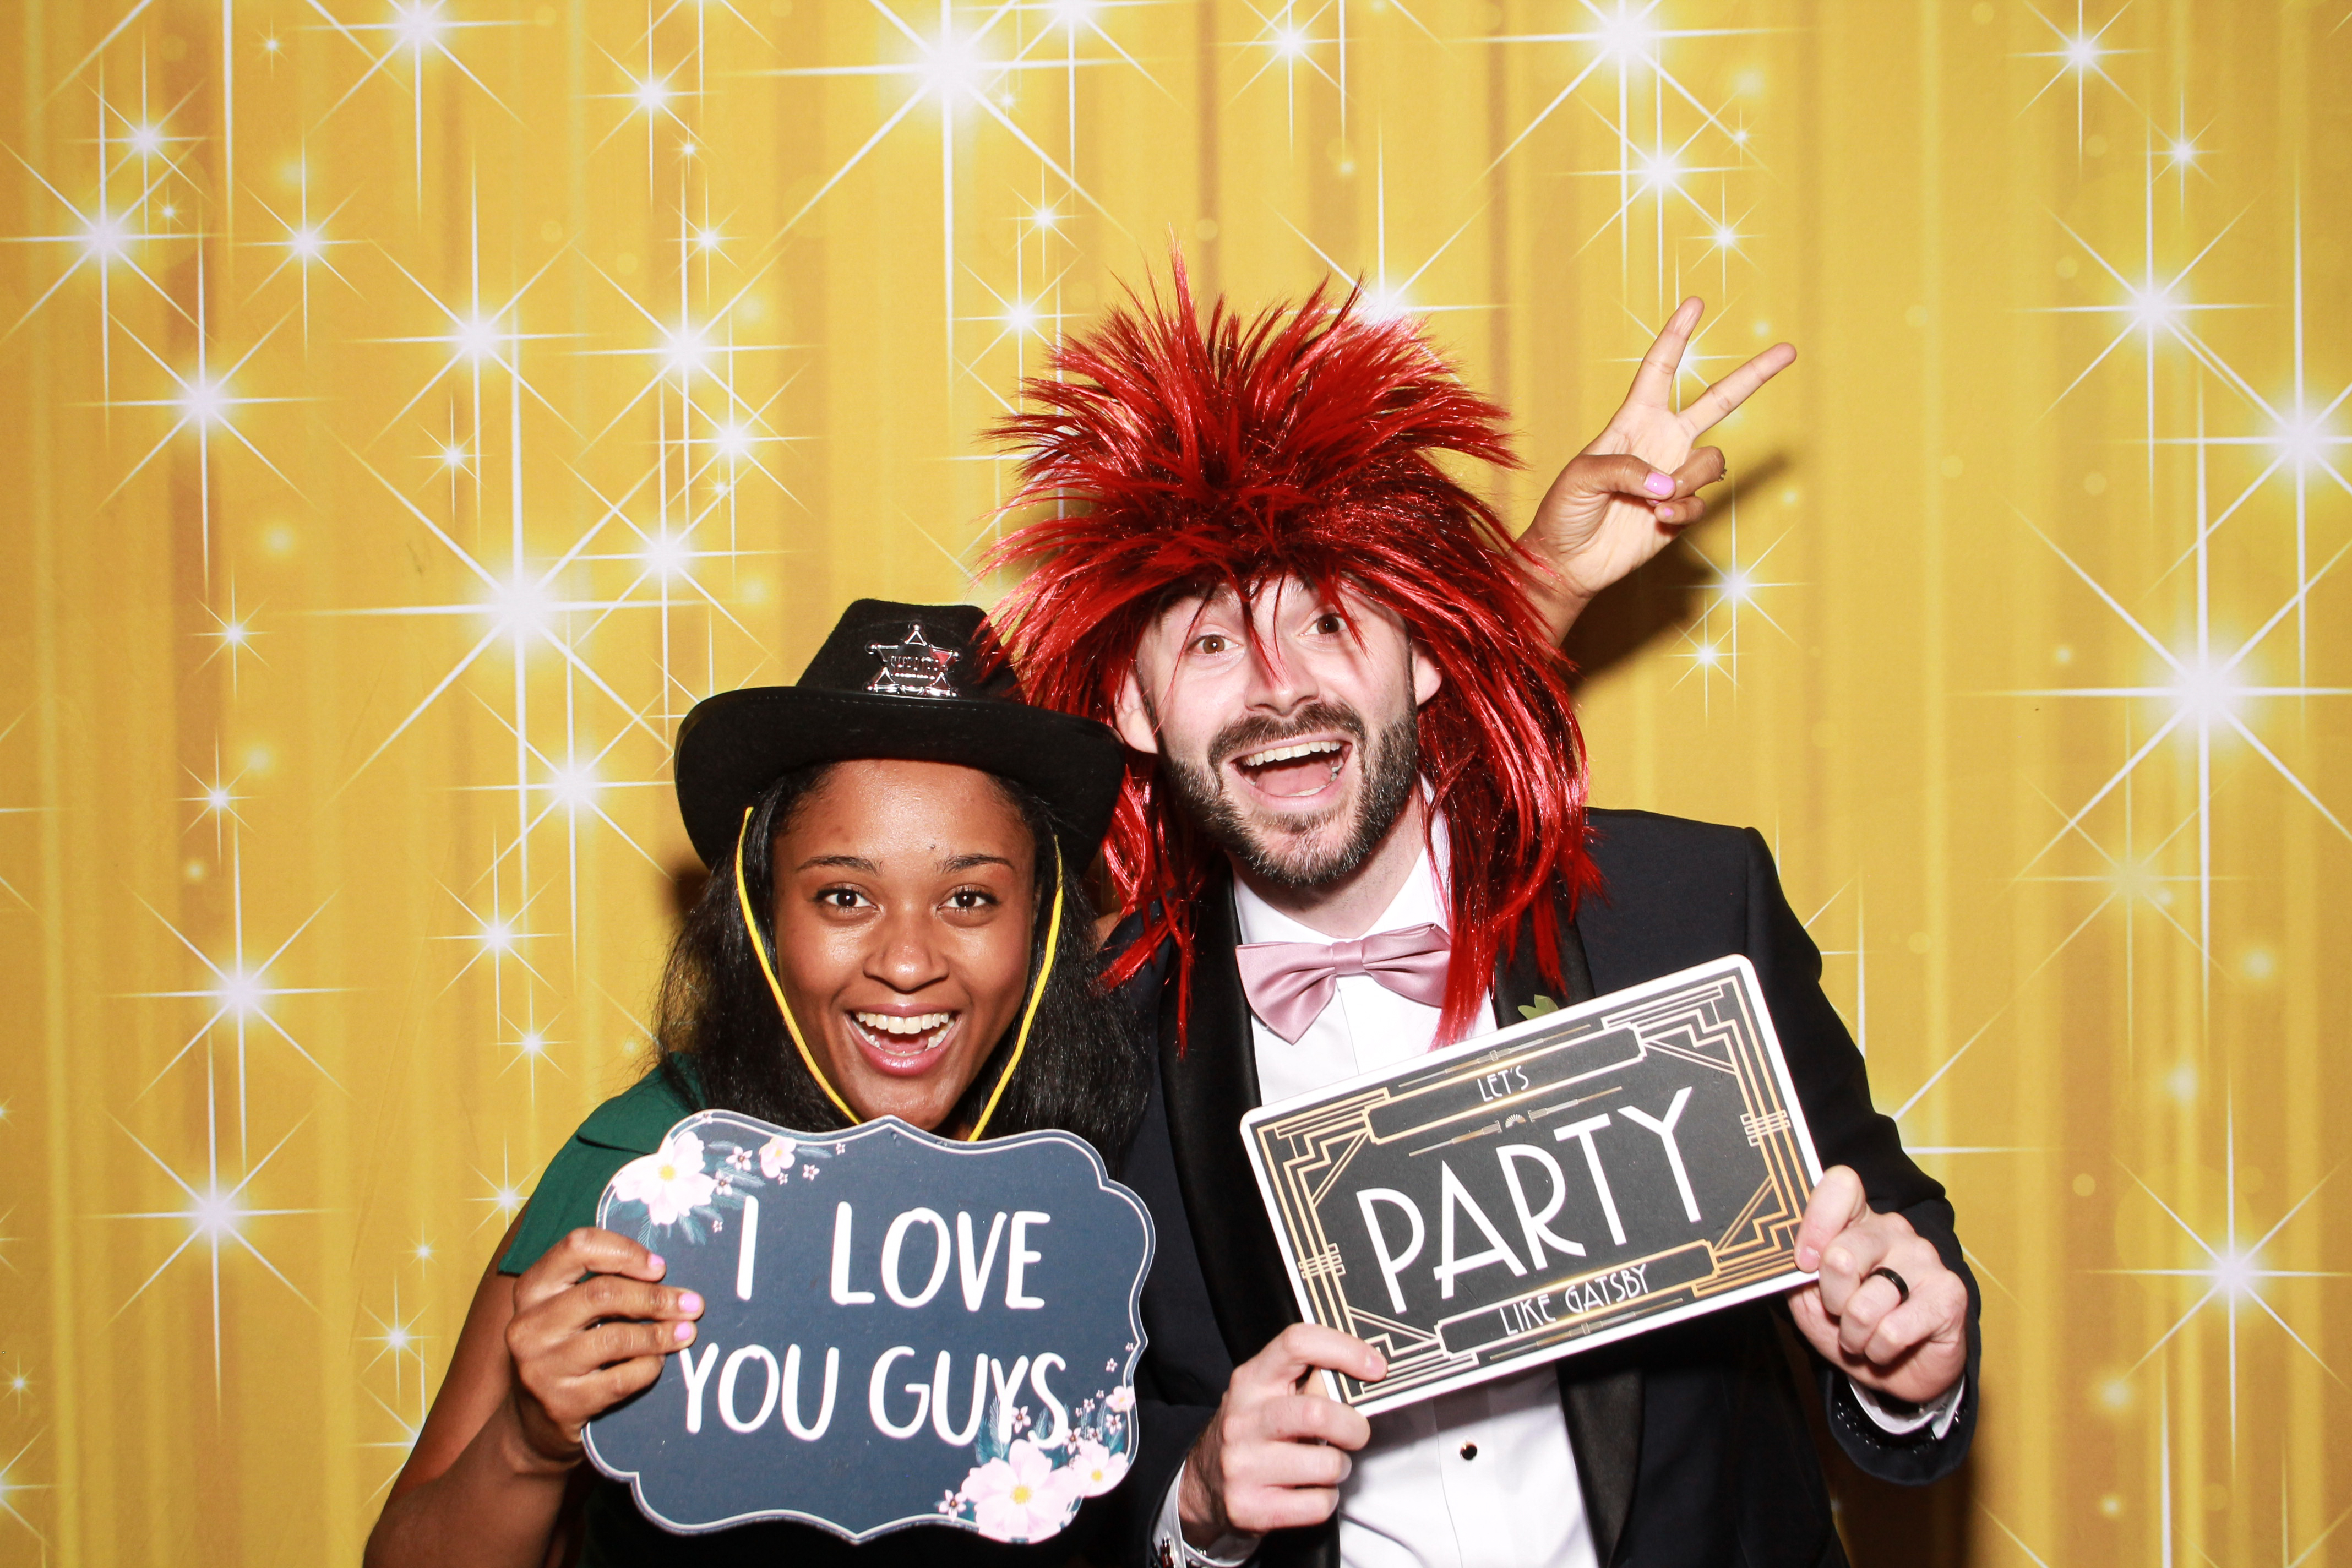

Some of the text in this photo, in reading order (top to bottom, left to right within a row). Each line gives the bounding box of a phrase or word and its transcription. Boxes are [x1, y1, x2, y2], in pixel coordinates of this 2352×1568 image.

[1477, 1065, 1529, 1102] LET'S
[736, 1194, 1052, 1312] I LOVE
[1355, 1086, 1702, 1315] PARTY
[1499, 1263, 1649, 1336] LIKE GATSBY
[679, 1342, 1069, 1450] YOU GUYS
